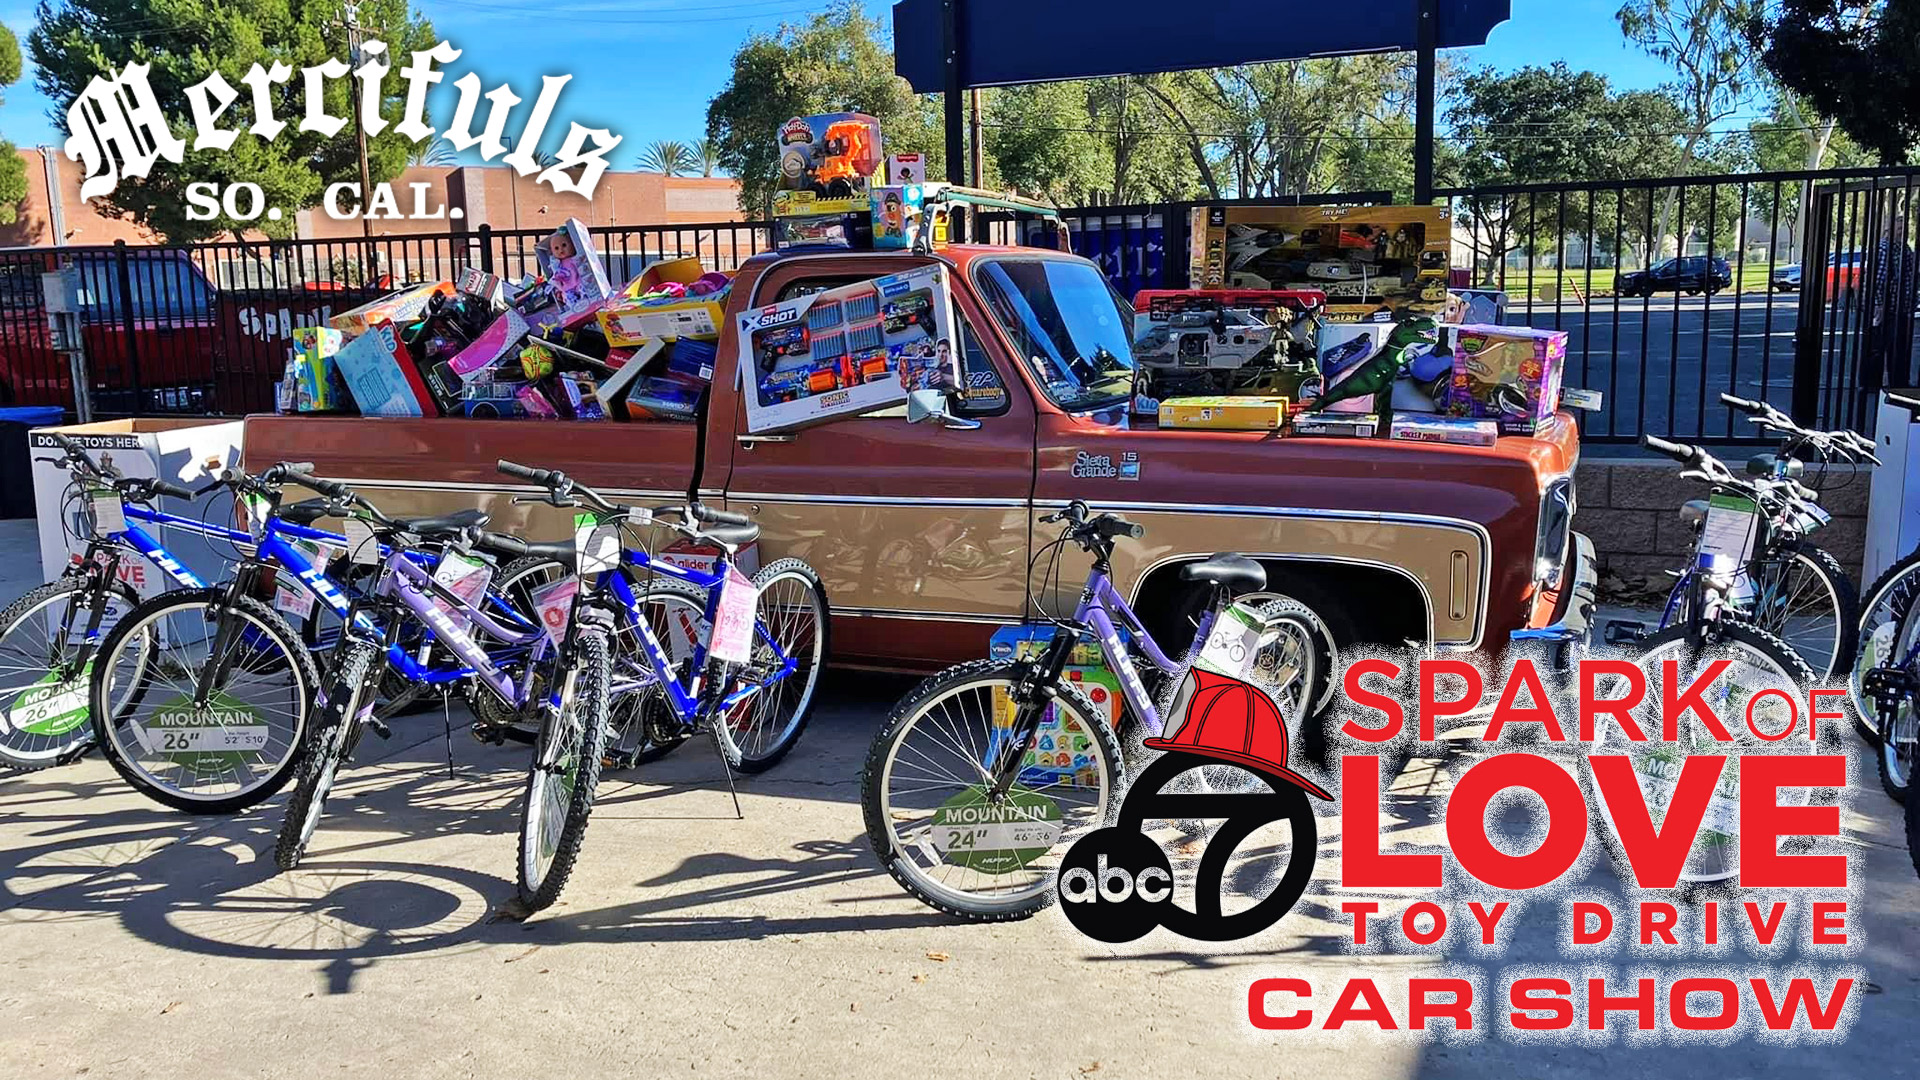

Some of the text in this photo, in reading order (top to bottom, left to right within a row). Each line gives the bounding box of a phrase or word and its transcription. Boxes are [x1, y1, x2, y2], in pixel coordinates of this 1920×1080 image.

[381, 327, 397, 352] KID
[1137, 398, 1159, 410] KID
[84, 437, 113, 448] TOYS
[116, 438, 143, 448] HER
[1076, 451, 1138, 467] Sierra 15
[1070, 463, 1118, 478] Grande
[159, 711, 254, 727] MOUNTAIN
[163, 732, 200, 750] 26"
[944, 805, 1048, 823] MOUNTAIN
[947, 829, 988, 850] 24"
